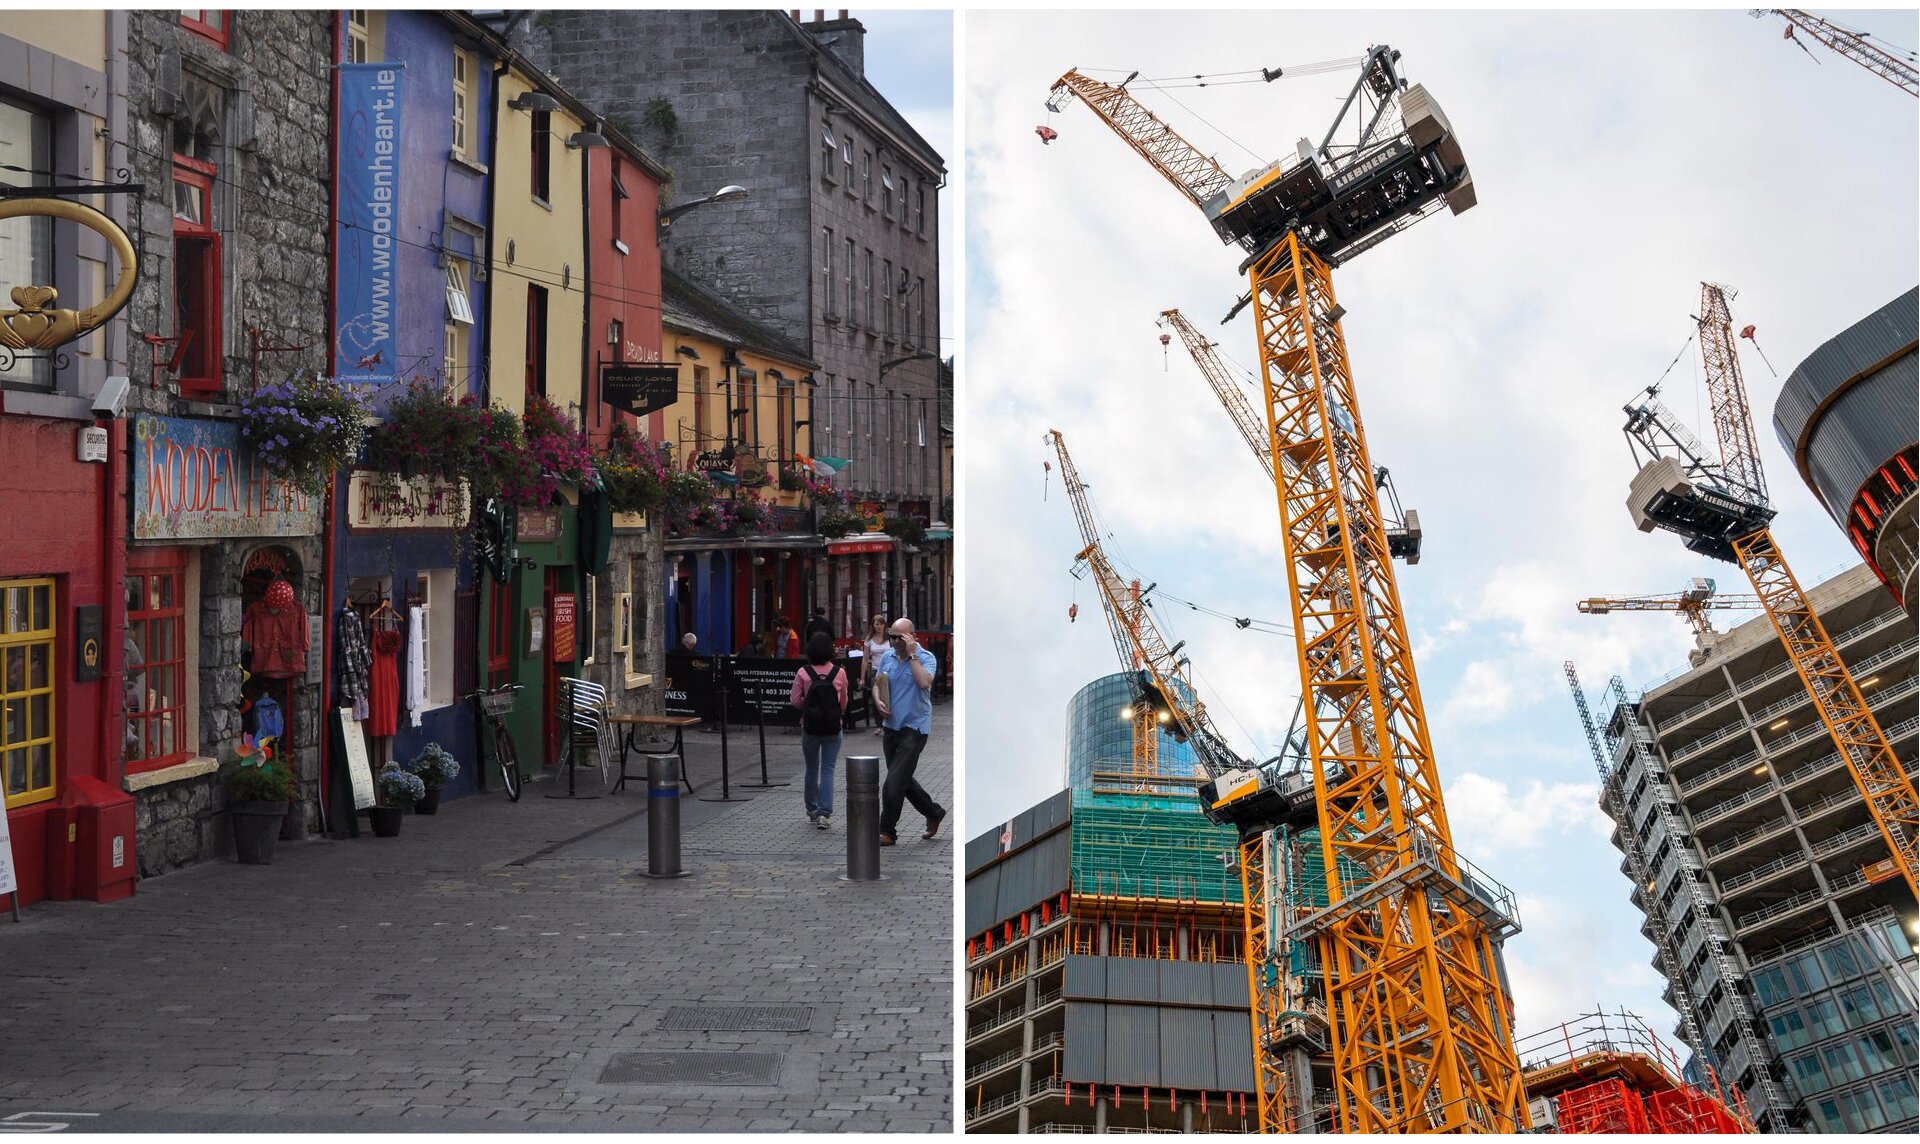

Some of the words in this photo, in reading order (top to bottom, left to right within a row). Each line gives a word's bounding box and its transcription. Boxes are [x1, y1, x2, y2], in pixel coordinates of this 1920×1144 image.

[1336, 146, 1398, 190] LIEBHERR
[367, 69, 396, 343] www.woodenheart.ie
[370, 373, 393, 381] Delivery
[699, 460, 729, 468] QUAYS
[146, 435, 241, 518] WOODEN
[1703, 493, 1747, 515] LIEBHERR
[555, 615, 573, 623] FOOD
